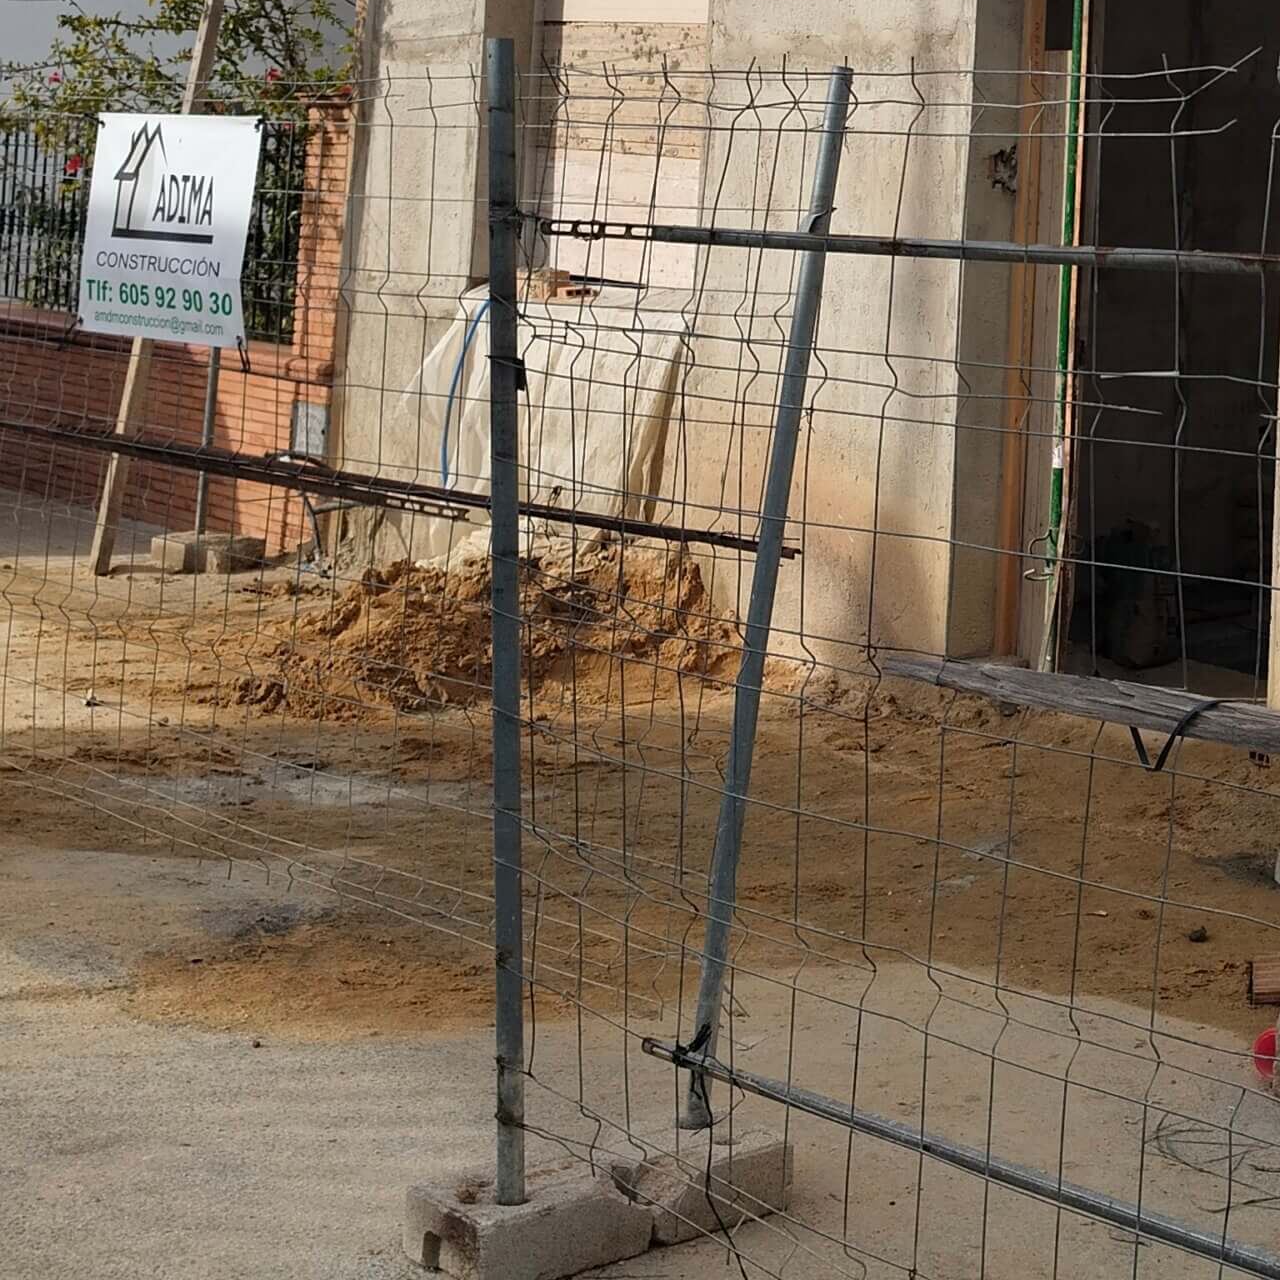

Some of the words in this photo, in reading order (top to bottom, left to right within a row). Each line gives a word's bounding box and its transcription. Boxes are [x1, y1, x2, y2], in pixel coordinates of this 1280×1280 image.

[152, 174, 214, 226] ADIMA
[96, 250, 220, 278] CONSTRUCCIÓN
[119, 282, 150, 306] 605
[155, 286, 176, 309] 92
[182, 289, 203, 312] 90
[209, 292, 233, 316] 30
